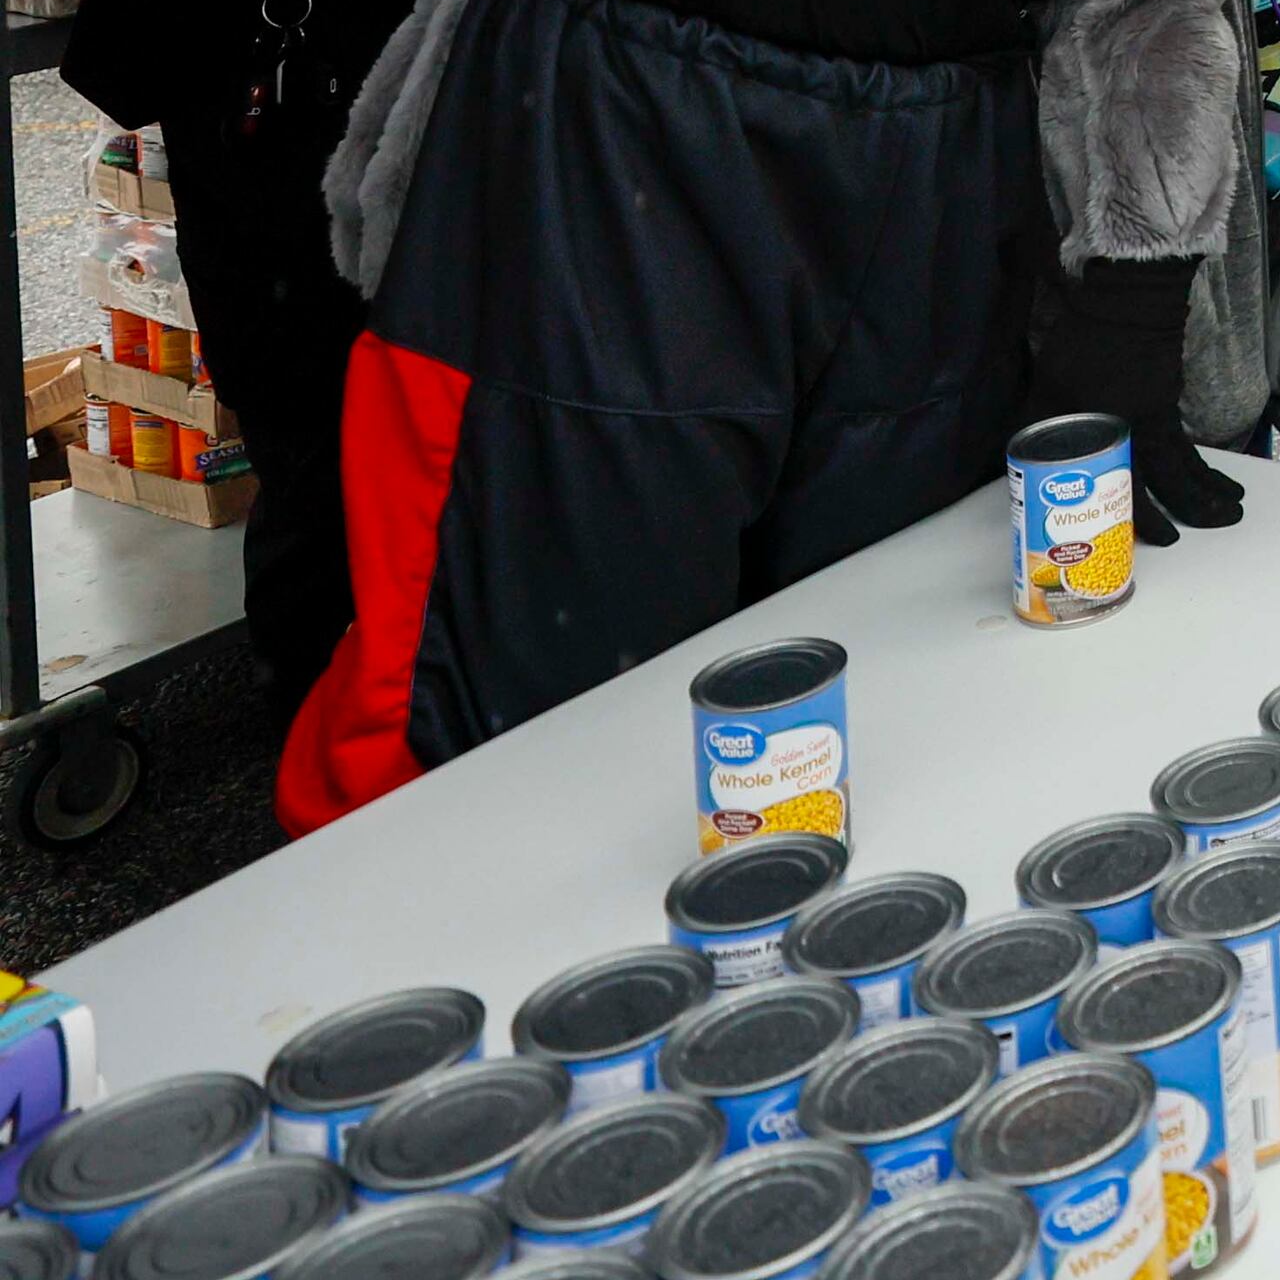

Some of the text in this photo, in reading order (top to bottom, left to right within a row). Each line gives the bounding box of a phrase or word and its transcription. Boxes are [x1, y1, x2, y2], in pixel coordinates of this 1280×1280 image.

[1045, 477, 1086, 494] Great
[1053, 507, 1101, 527] Whole
[709, 731, 754, 750] Great
[717, 746, 831, 789] Whole Kernel
[796, 765, 832, 790] Corn
